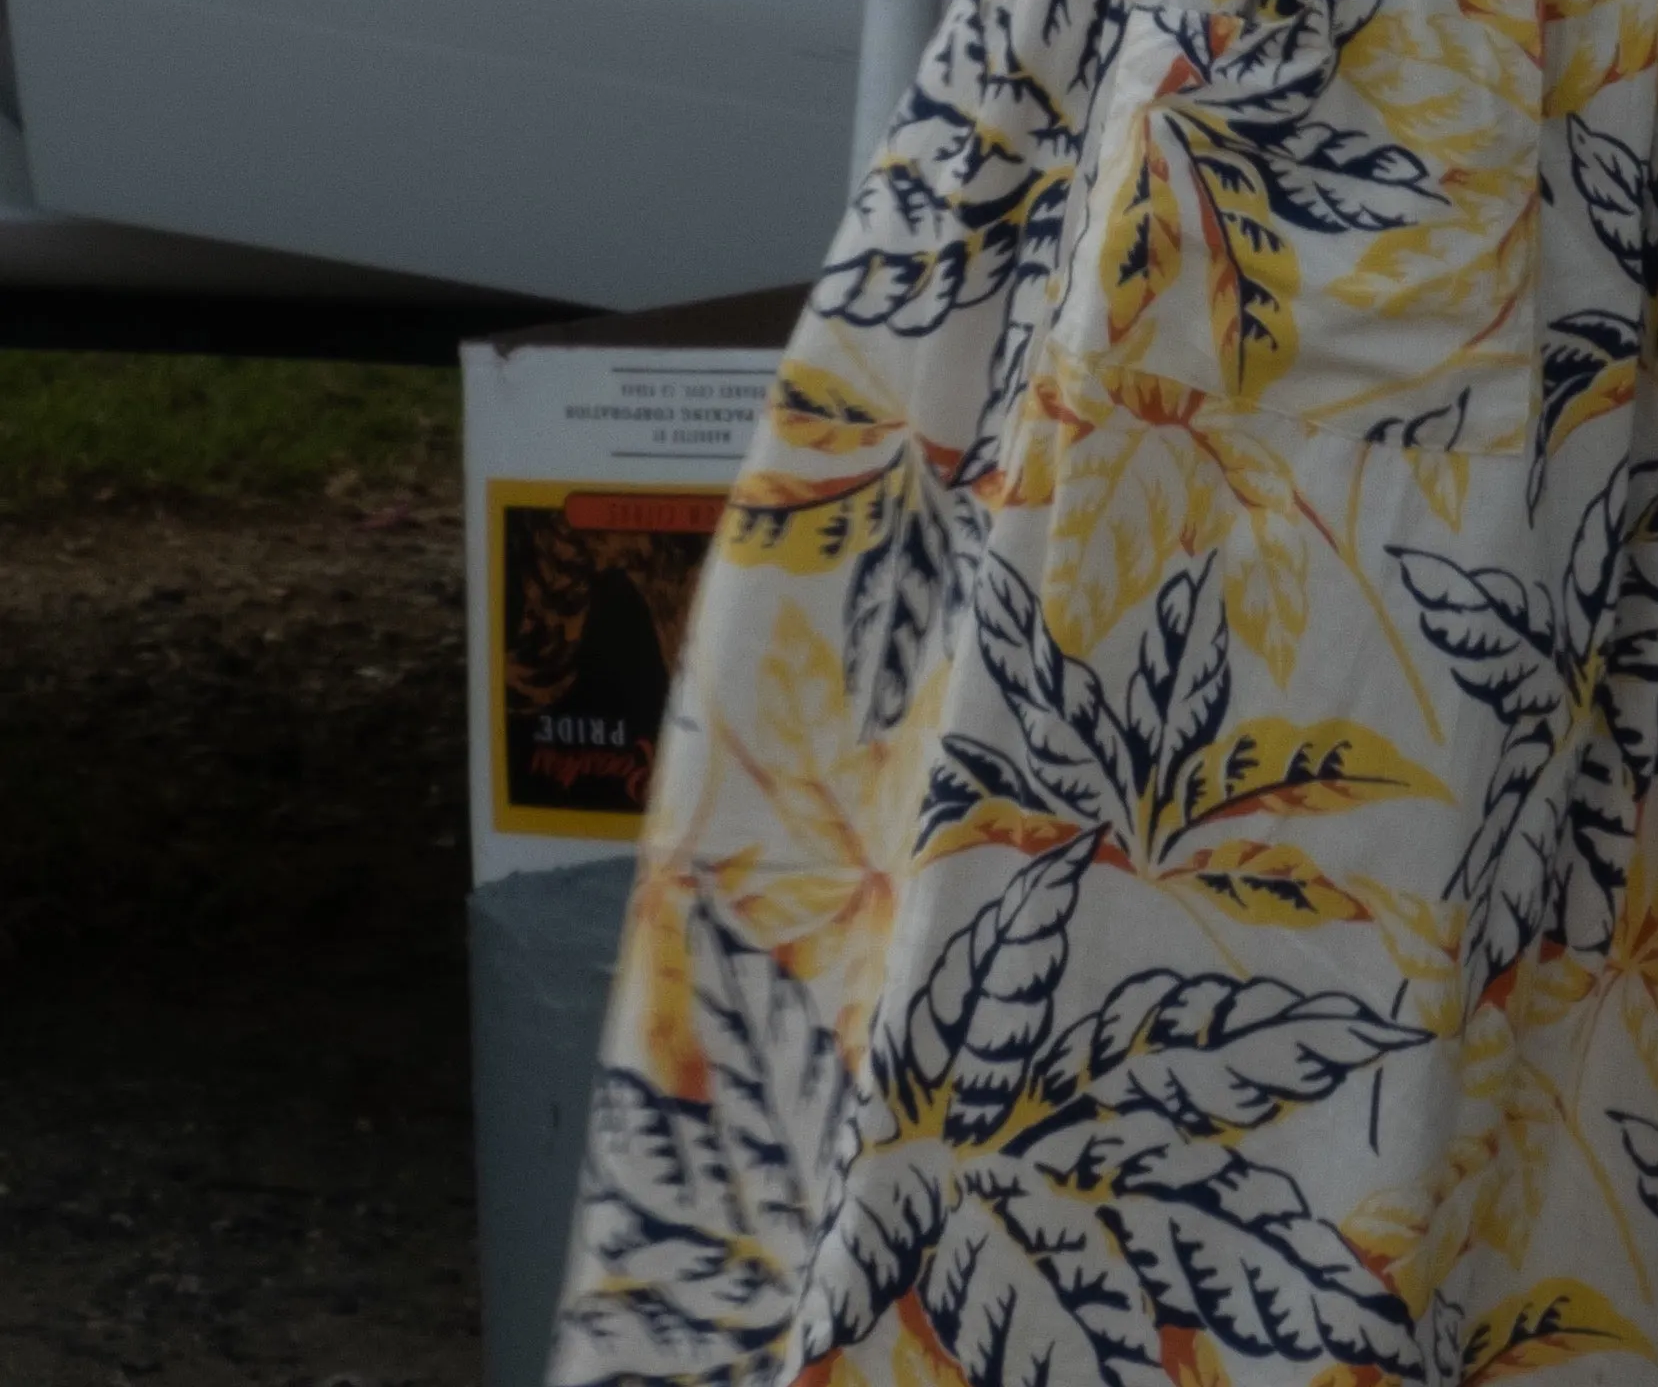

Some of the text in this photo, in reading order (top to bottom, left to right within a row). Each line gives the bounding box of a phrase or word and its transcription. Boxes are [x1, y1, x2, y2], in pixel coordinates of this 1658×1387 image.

[564, 404, 755, 423] PACKING CORPORATION
[539, 715, 626, 748] PRIDE
